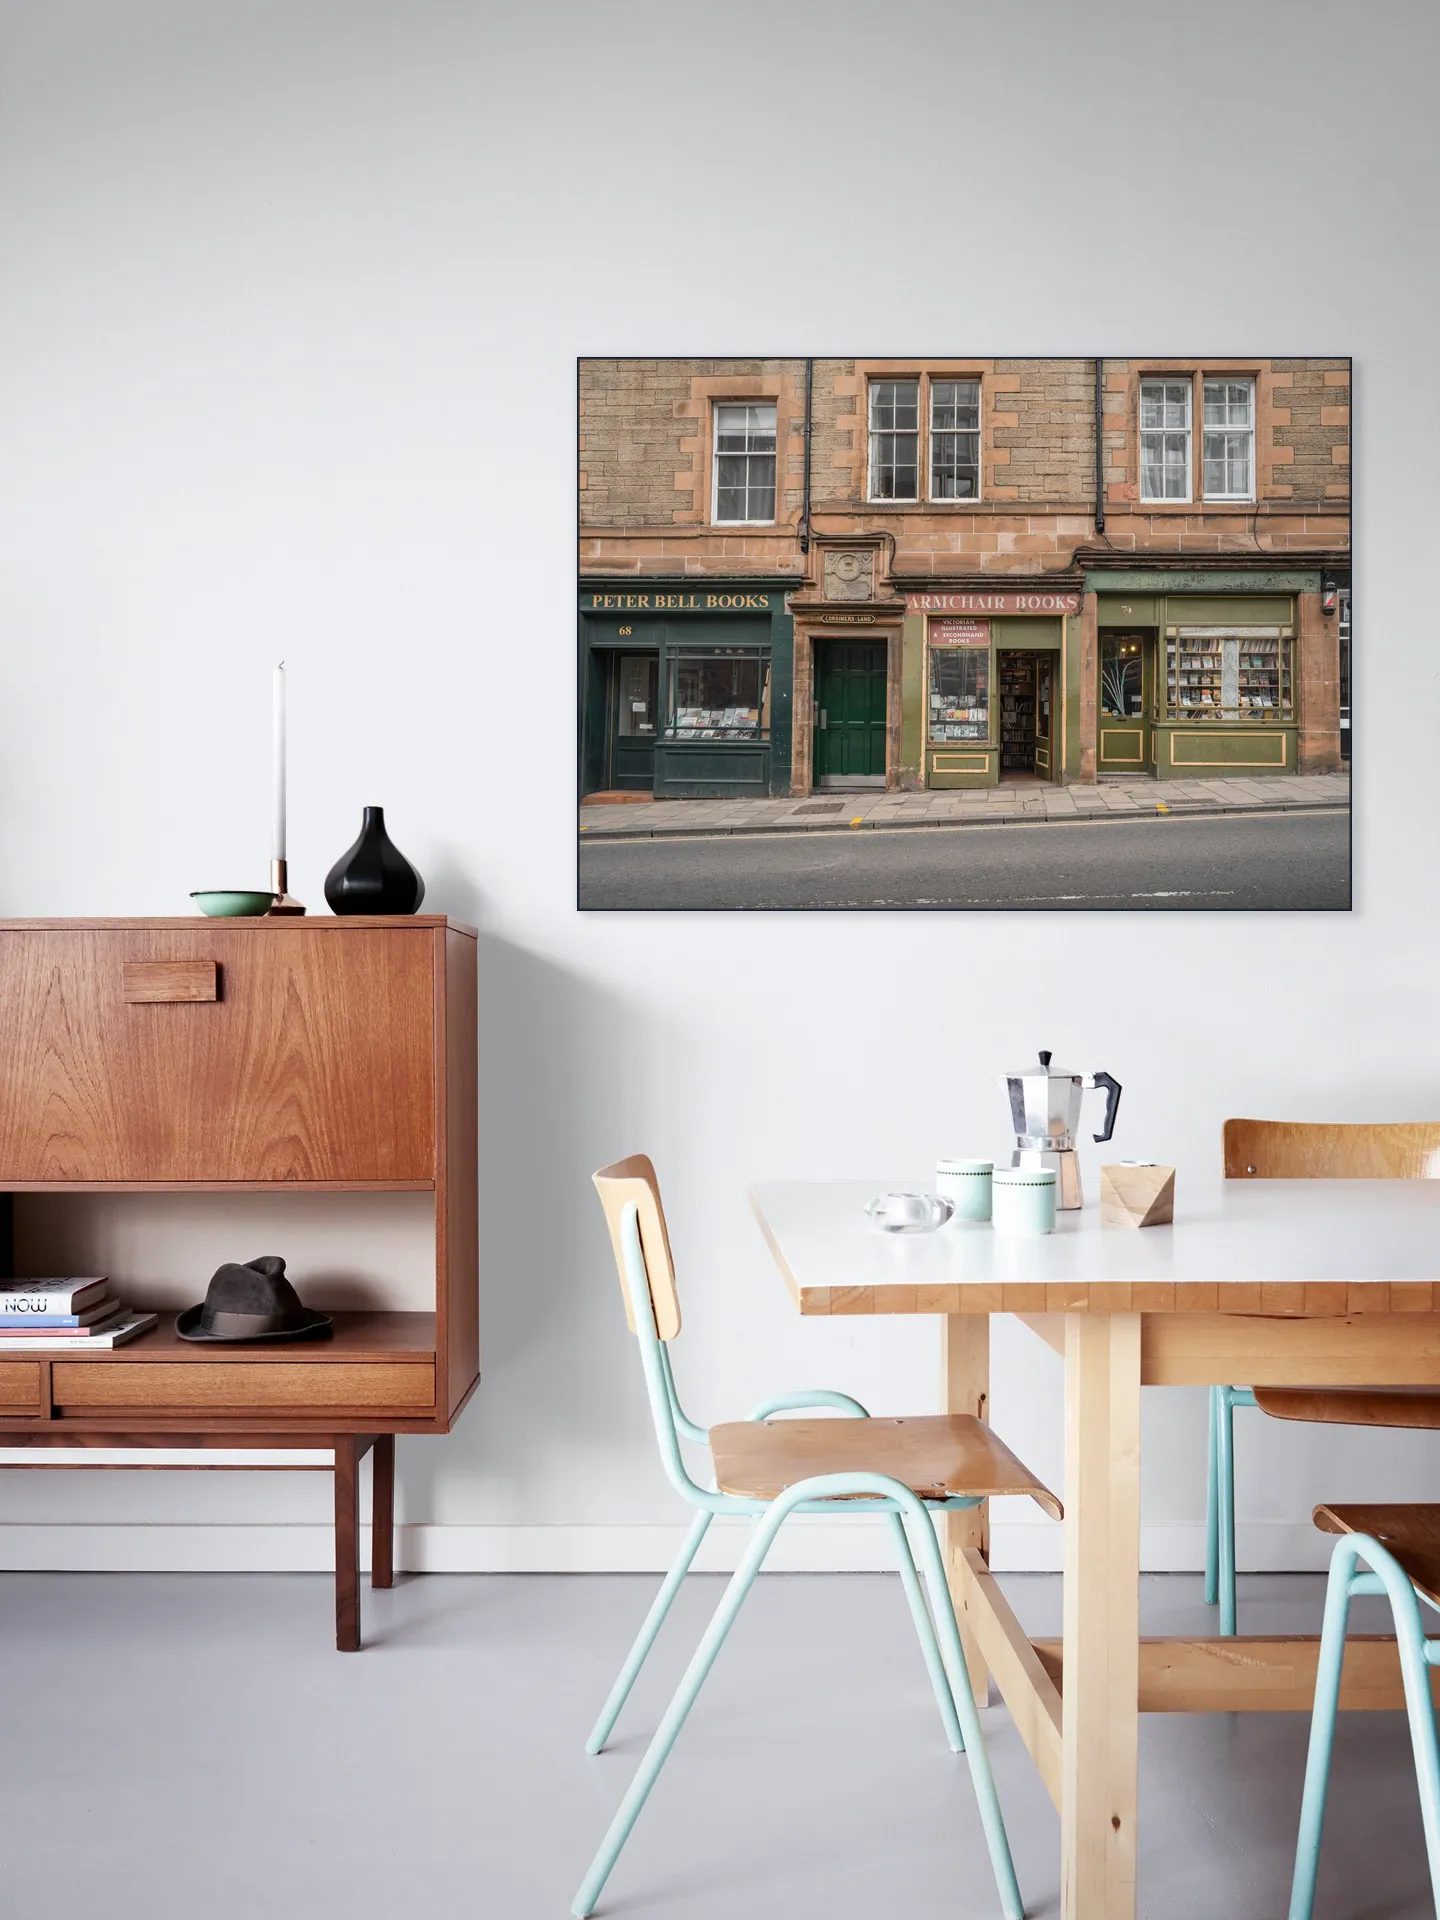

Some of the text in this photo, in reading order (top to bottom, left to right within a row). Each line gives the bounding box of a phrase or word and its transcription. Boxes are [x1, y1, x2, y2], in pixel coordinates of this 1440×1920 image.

[592, 594, 769, 608] PETER BELL BOOKS
[908, 595, 1078, 609] ARMCHAIR BOOKS
[1121, 604, 1132, 614] 74
[619, 625, 632, 636] 68
[5, 1298, 47, 1313] NOW
